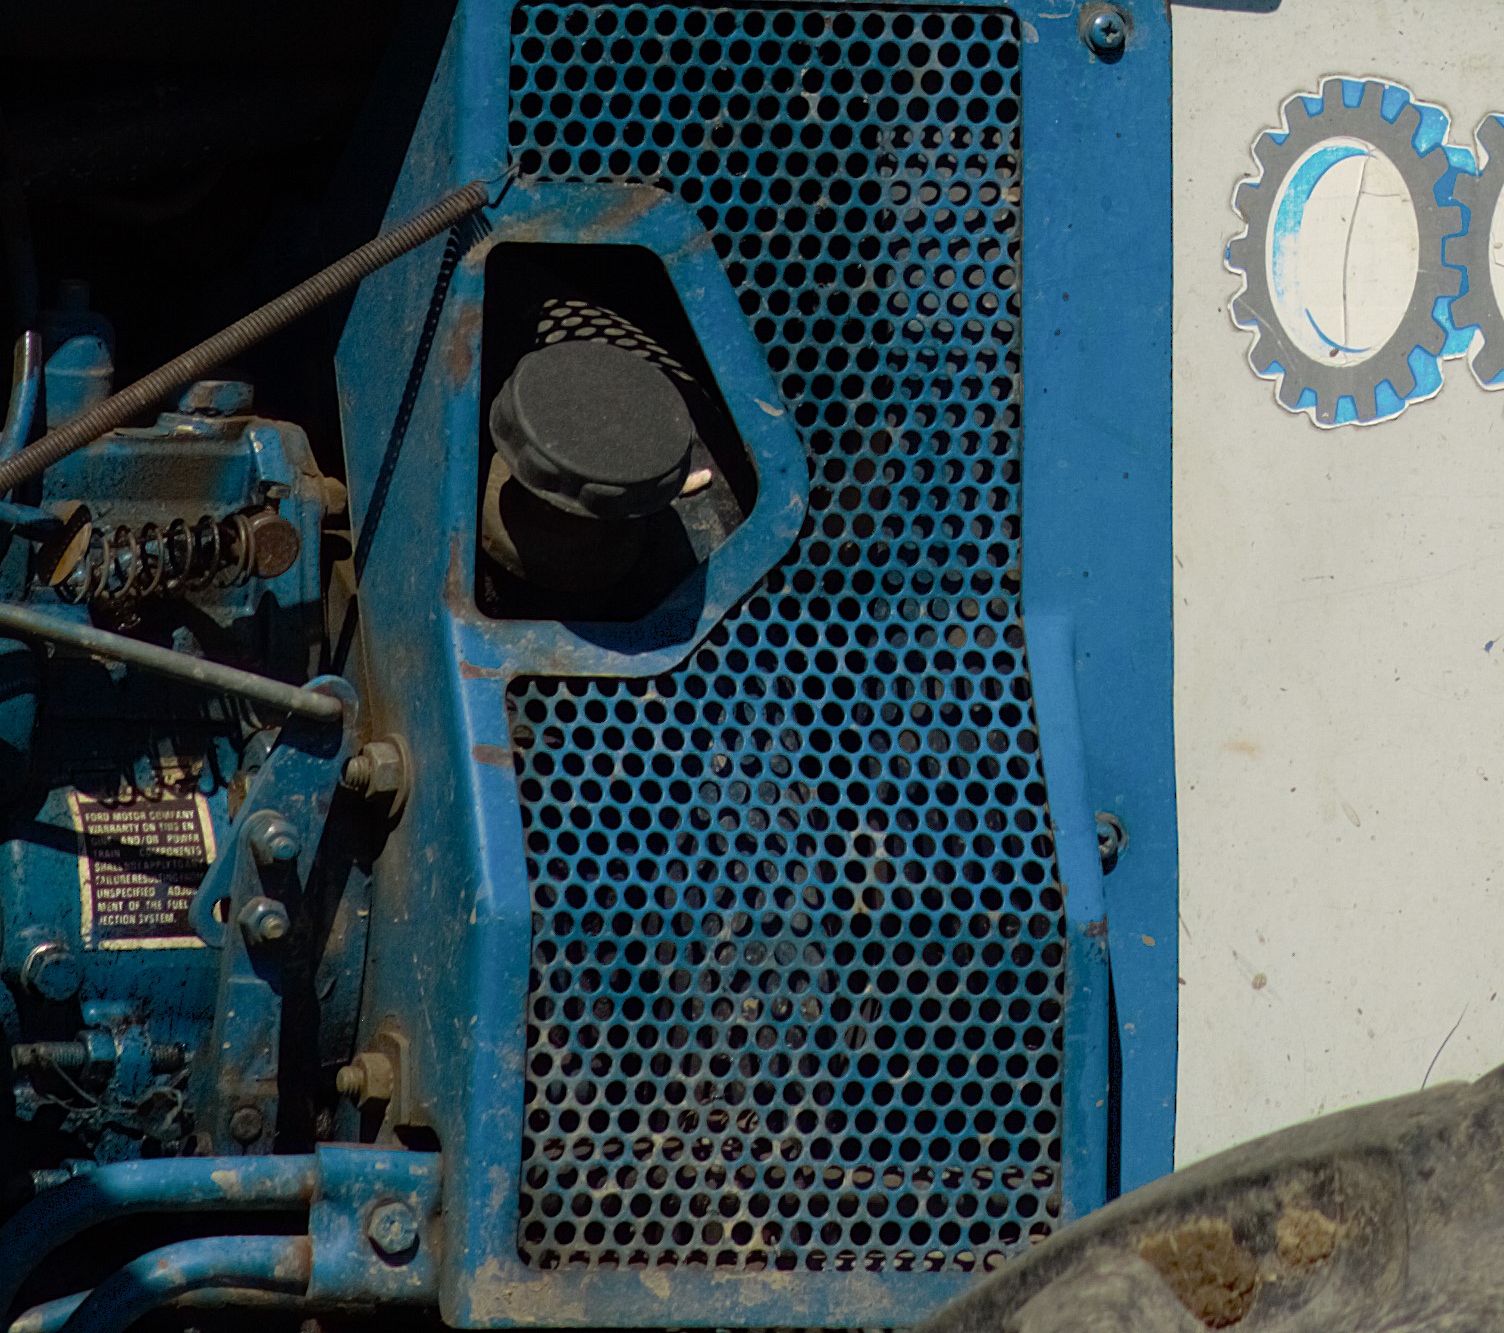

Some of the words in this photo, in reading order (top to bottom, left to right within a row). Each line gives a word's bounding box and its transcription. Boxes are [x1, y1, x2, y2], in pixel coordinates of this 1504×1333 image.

[84, 812, 110, 822] FORD
[112, 811, 146, 821] MOTOR
[148, 810, 194, 820] COMPANY
[87, 823, 139, 834] WARRANTY
